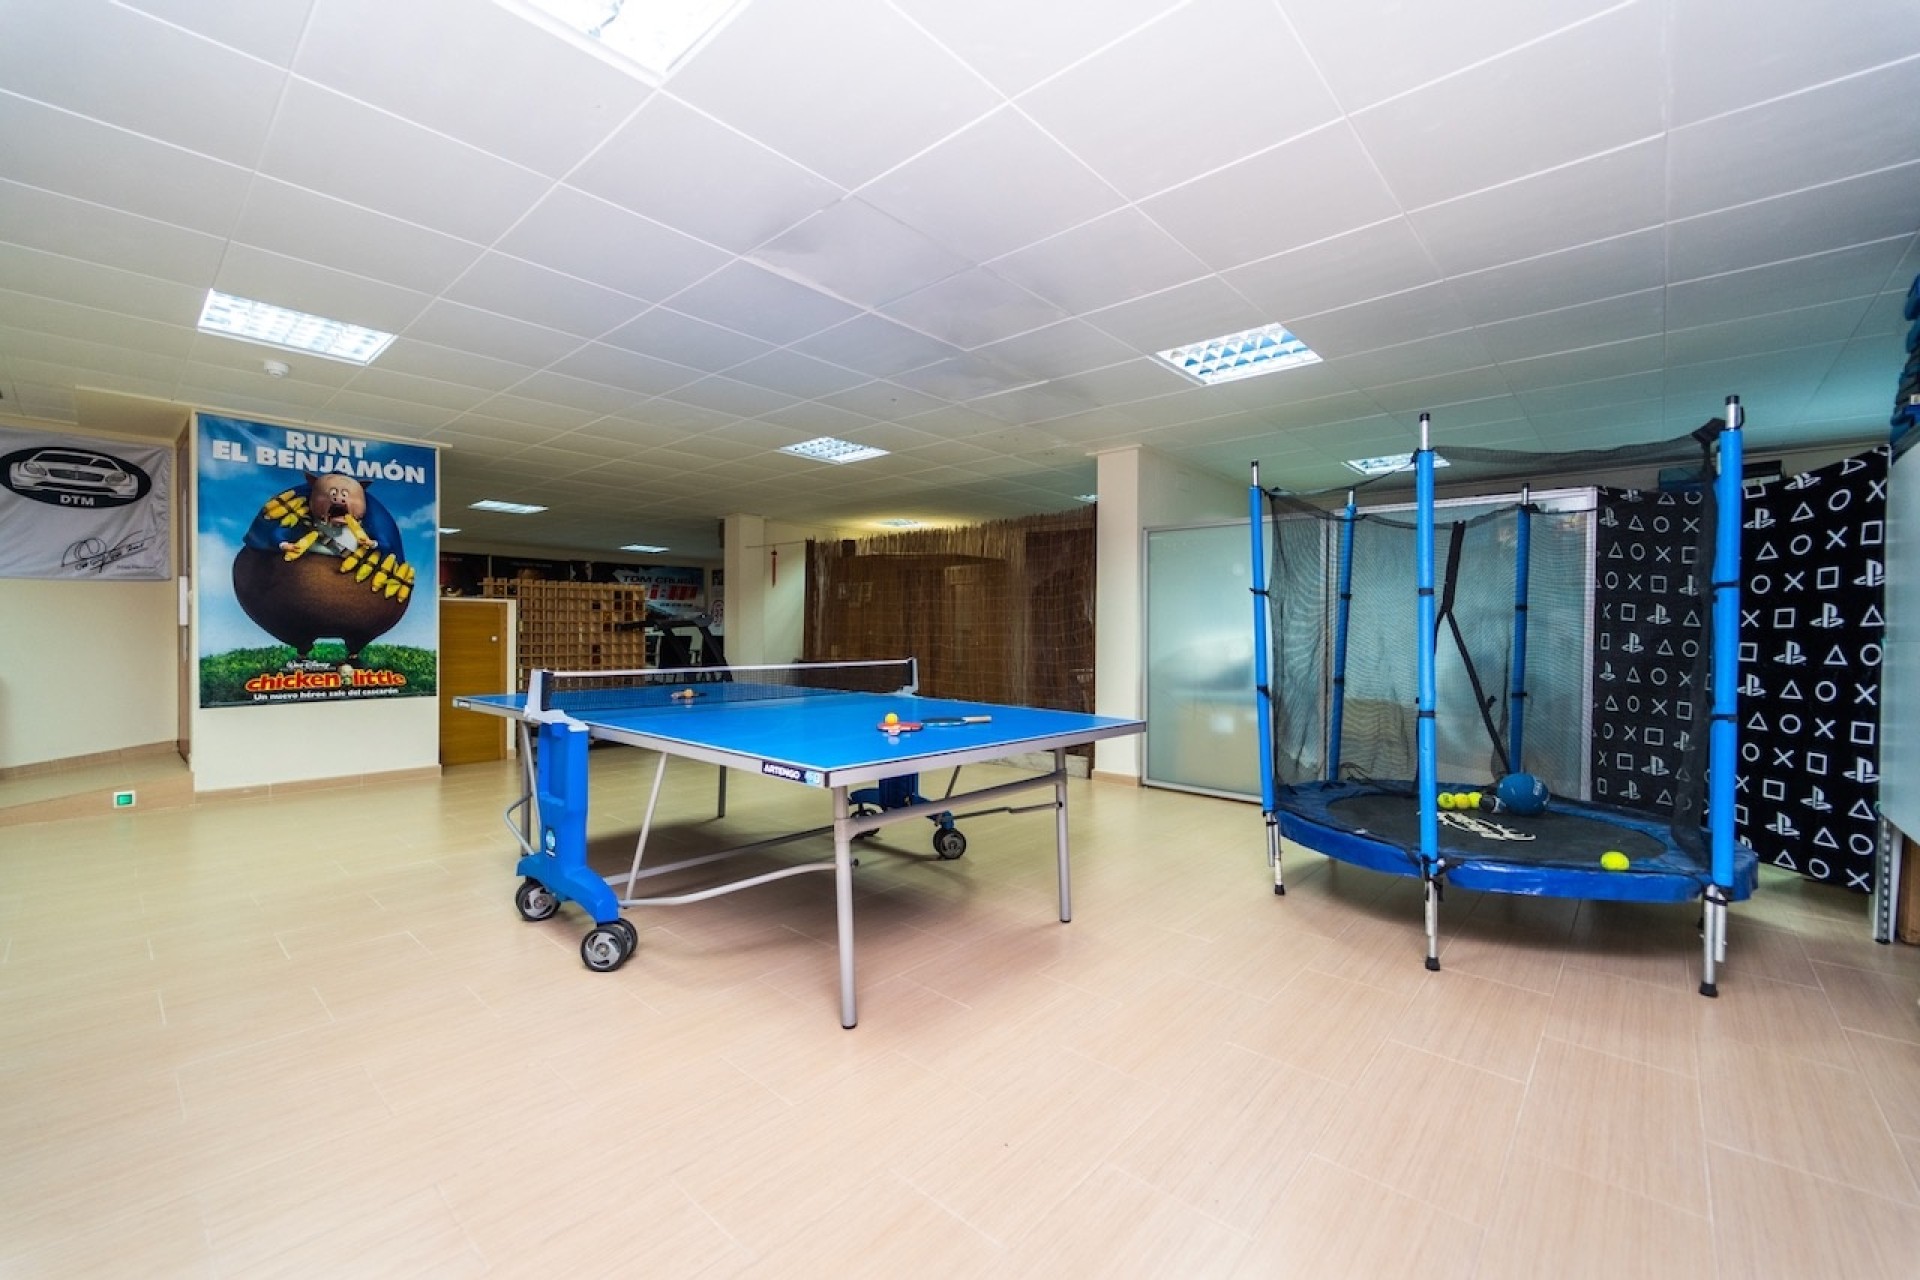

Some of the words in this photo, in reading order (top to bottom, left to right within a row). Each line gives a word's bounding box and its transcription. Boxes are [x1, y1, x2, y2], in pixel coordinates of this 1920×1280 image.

[286, 431, 367, 459] RUNT
[212, 440, 248, 463] EL
[256, 446, 425, 484] BENJAMÓN
[60, 494, 95, 506] DTM
[623, 575, 652, 583] TOM
[246, 670, 341, 691] chicken
[353, 669, 406, 687] little
[347, 688, 361, 696] del
